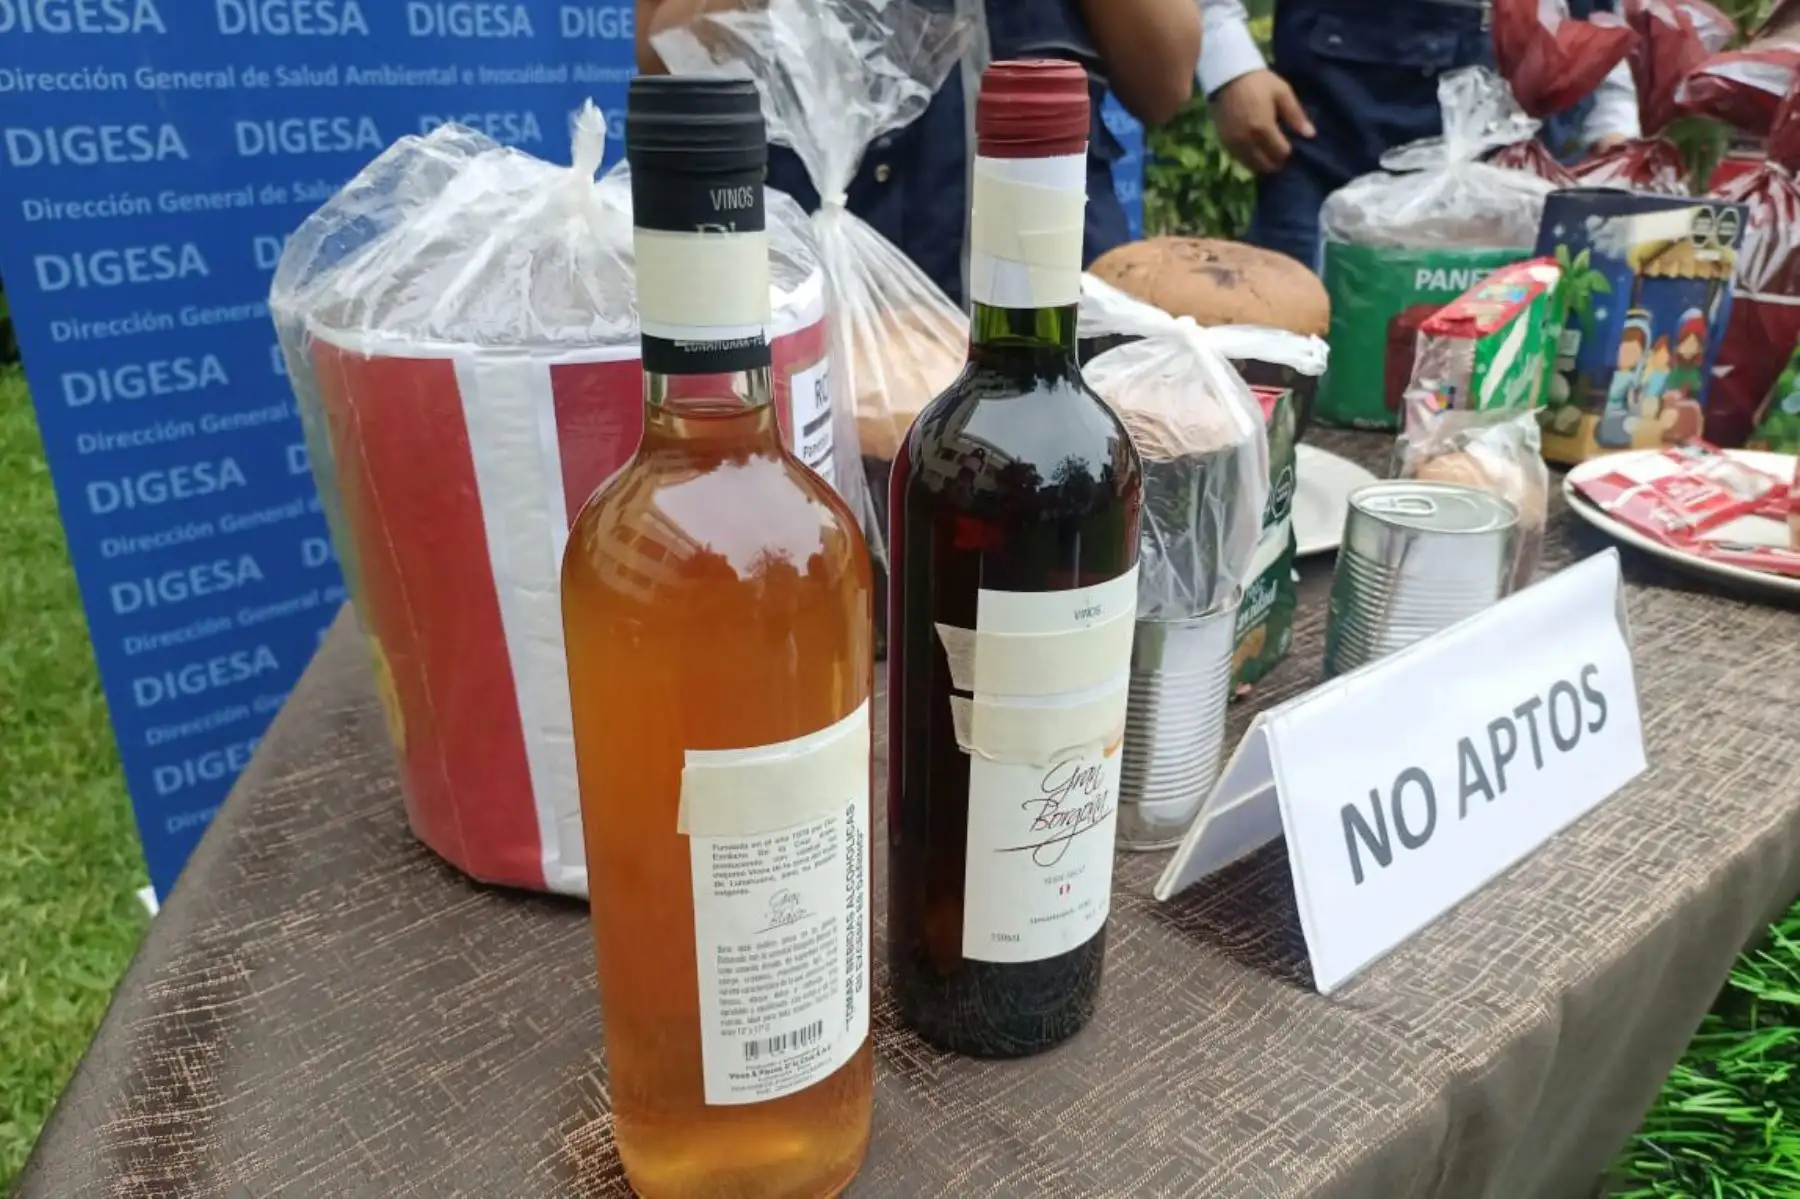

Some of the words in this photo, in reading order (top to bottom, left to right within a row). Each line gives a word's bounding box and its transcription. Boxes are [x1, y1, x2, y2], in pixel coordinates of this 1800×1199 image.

[216, 0, 370, 36] DIGESA
[407, 2, 535, 38] DIGESA
[0, 66, 127, 91] Dirección
[135, 65, 236, 90] General
[241, 64, 270, 88] de
[275, 63, 338, 87] Salud
[345, 62, 457, 86] Ambiental
[462, 68, 475, 84] e
[478, 63, 568, 84] Inocuidad
[5, 124, 189, 166] DIGESA
[236, 116, 383, 156] DIGESA
[22, 192, 152, 222] Dirección
[158, 185, 253, 213] General
[260, 184, 288, 205] de
[293, 178, 344, 203] Salu
[710, 184, 754, 211] VINOS
[35, 243, 210, 291] DIGESA
[51, 312, 174, 342] Dirección
[61, 354, 230, 407] DIGESA
[76, 411, 195, 454] Dirección
[200, 401, 289, 433] General
[86, 457, 248, 514] DIGESA
[101, 521, 214, 558] Dirección
[219, 498, 304, 533] General
[109, 554, 265, 615] DIGESA
[124, 615, 231, 656] Dirección
[132, 643, 279, 707] DIGESA
[1340, 766, 1437, 886] NO
[1457, 663, 1607, 820] APTOS
